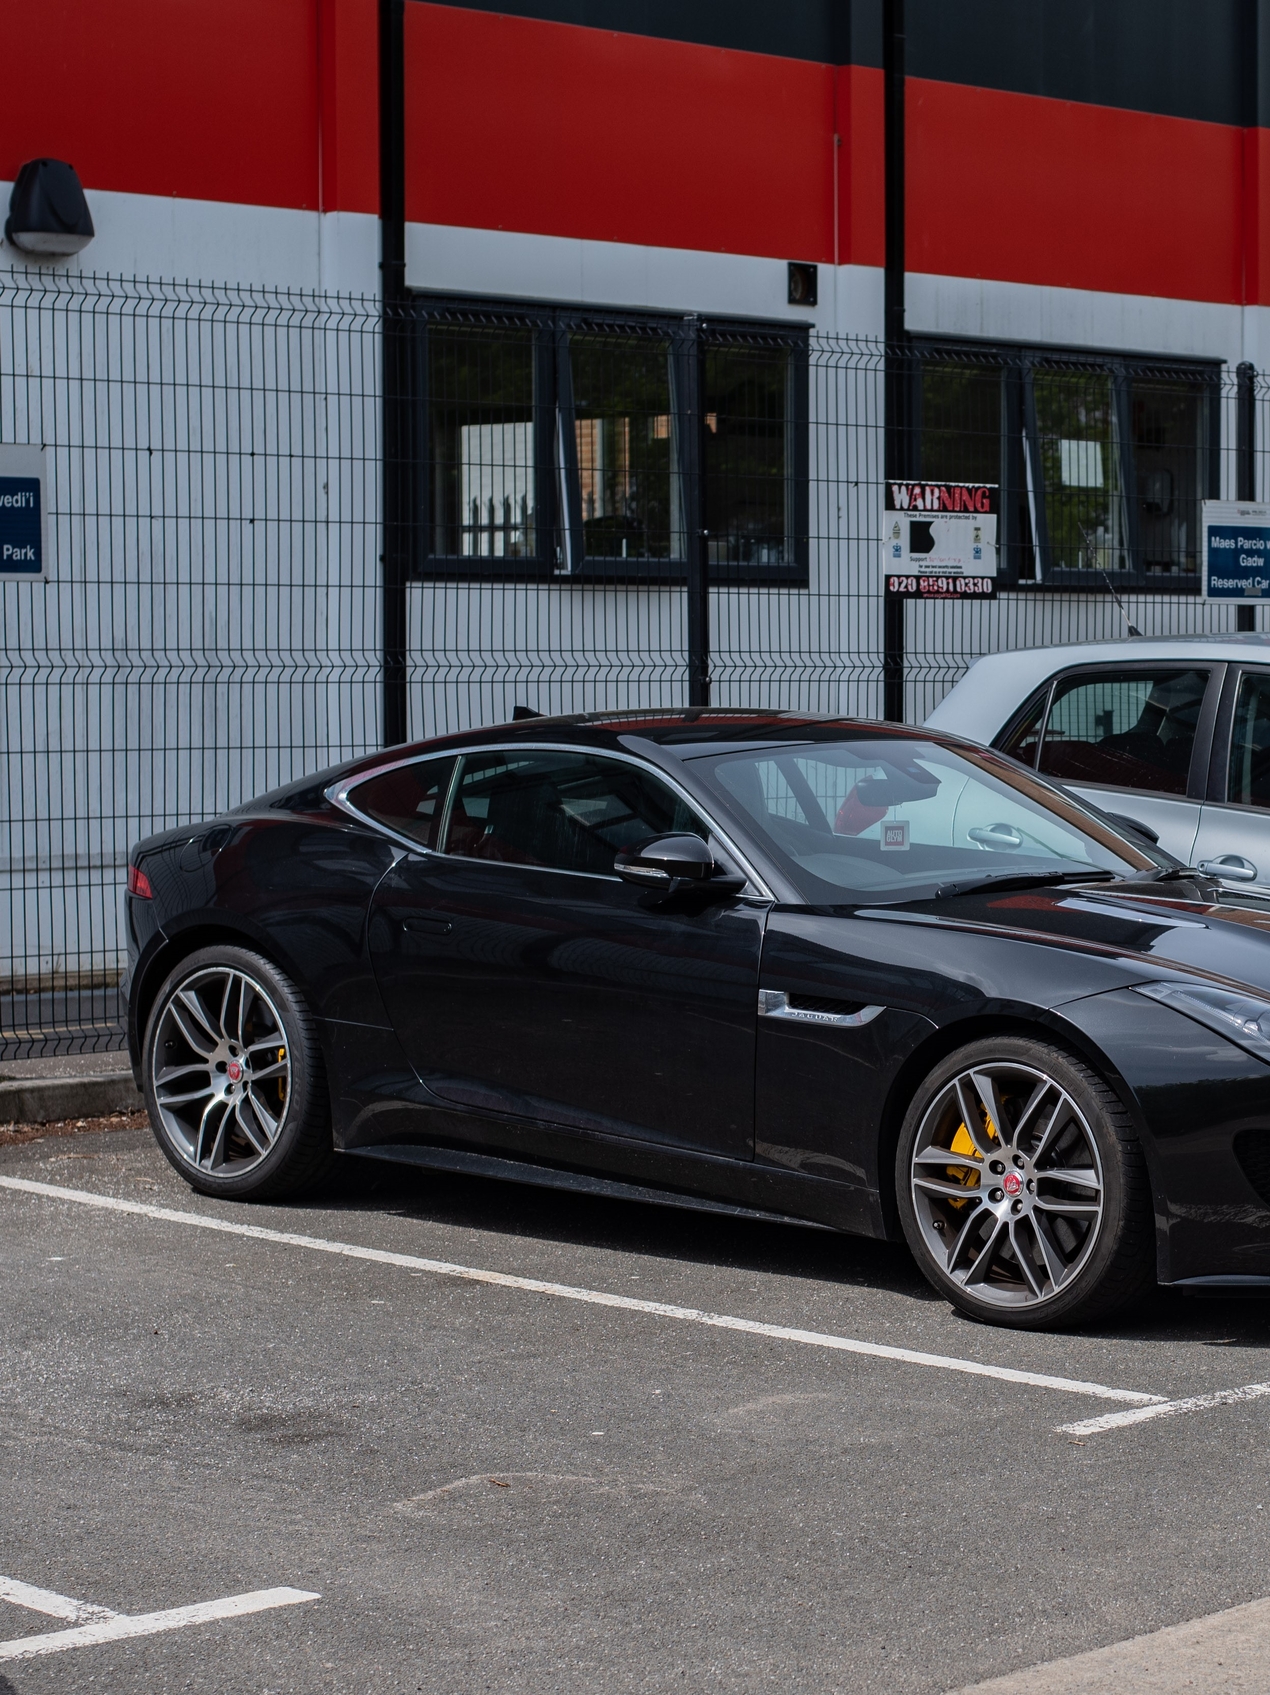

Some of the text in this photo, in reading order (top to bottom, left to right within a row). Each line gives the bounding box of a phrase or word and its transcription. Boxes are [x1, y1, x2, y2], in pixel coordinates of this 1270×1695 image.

[0, 491, 34, 508] edi'i
[891, 484, 990, 512] WARNING
[1211, 536, 1235, 549] Maes
[1237, 537, 1265, 550] Parcio
[3, 544, 35, 561] Park
[1239, 554, 1265, 567] Gadw
[889, 576, 992, 593] 020 8591 0330
[1211, 576, 1253, 589] Reserved
[1254, 577, 1270, 589] Car
[791, 1011, 838, 1022] JAGUAR
